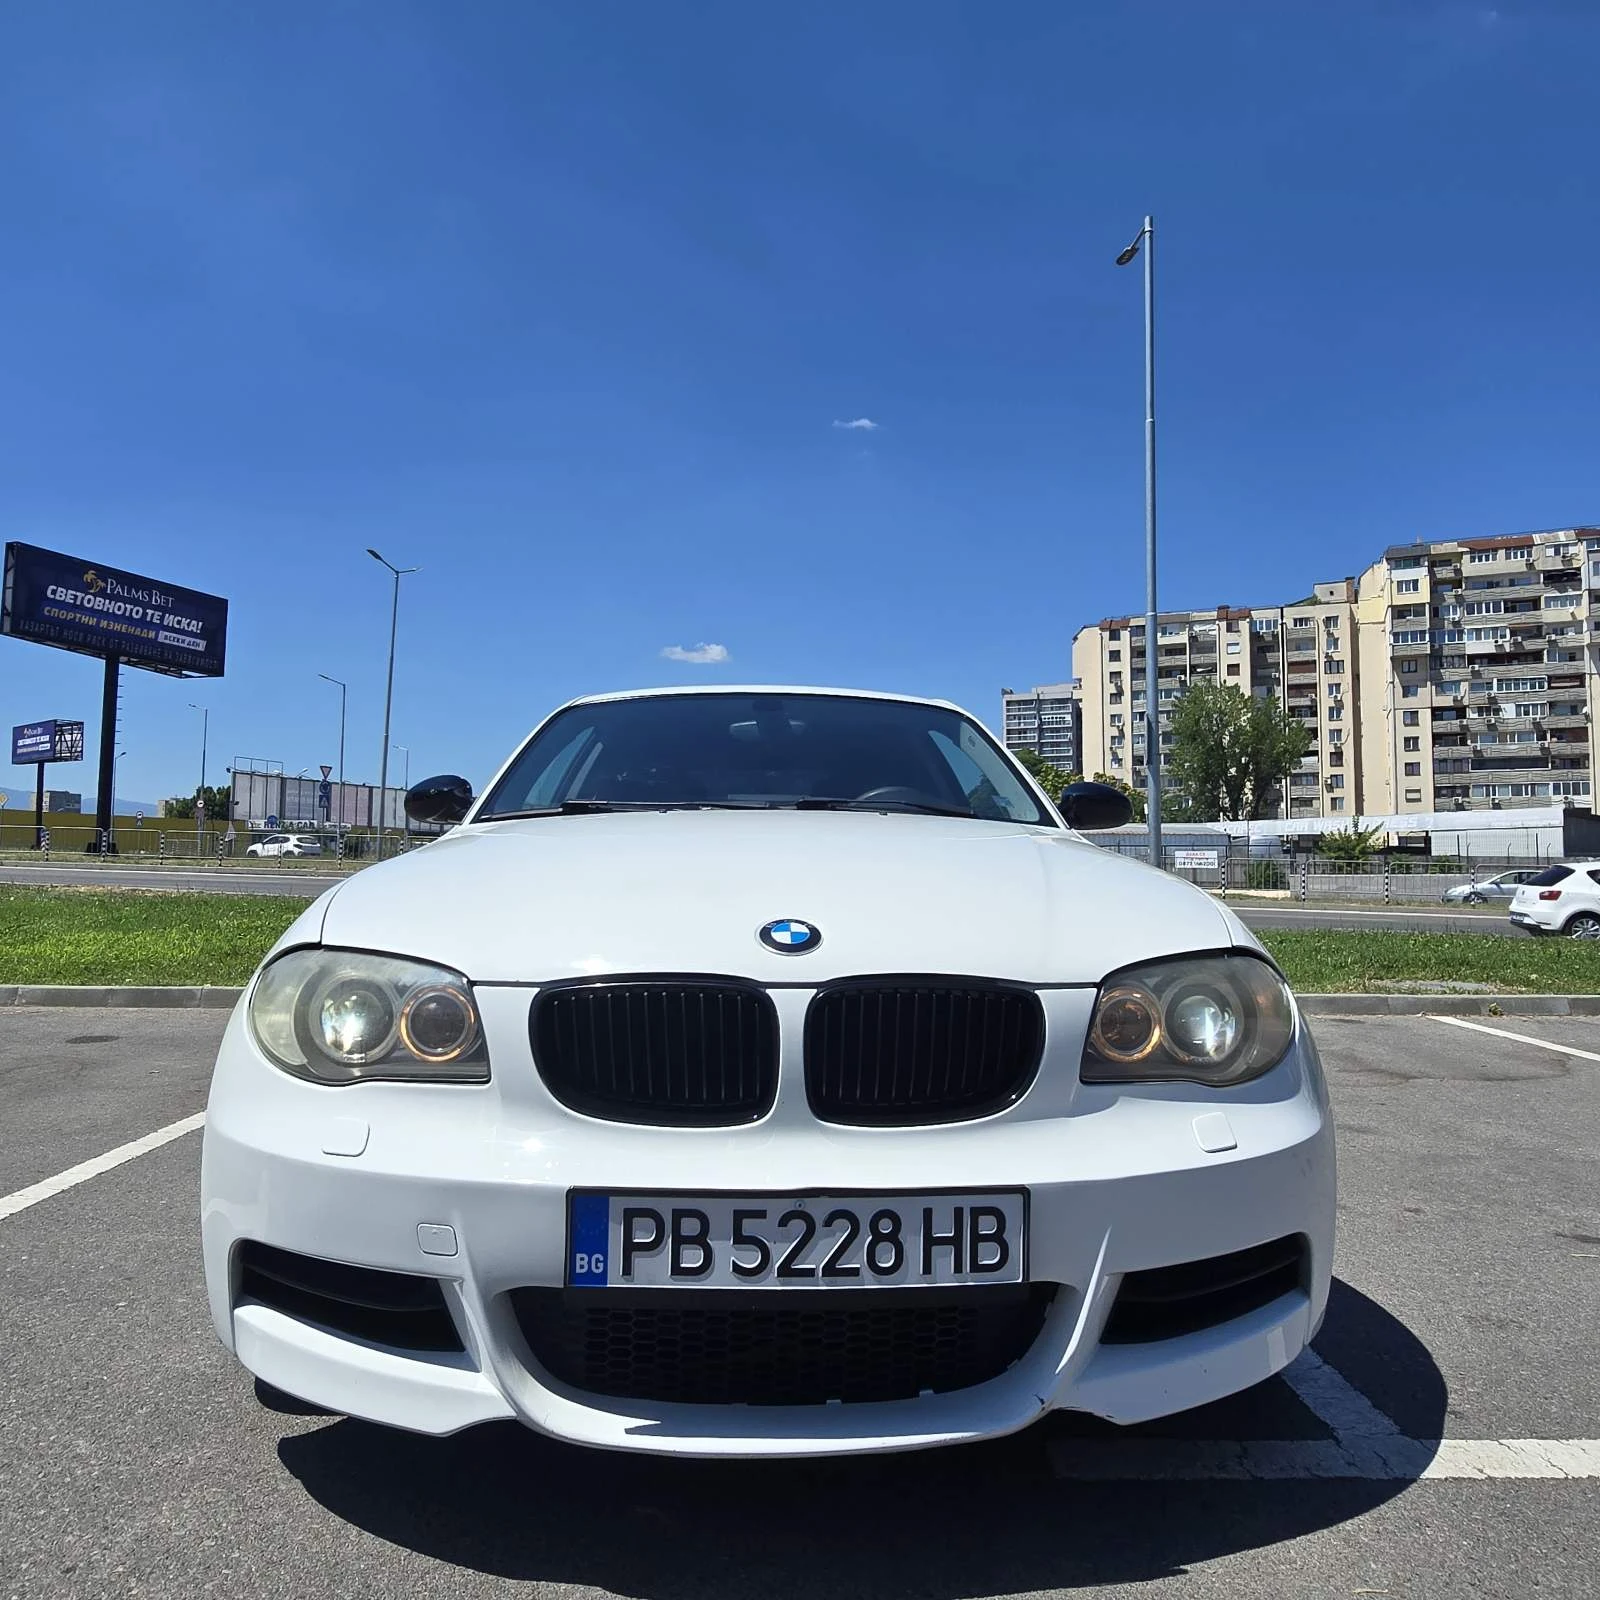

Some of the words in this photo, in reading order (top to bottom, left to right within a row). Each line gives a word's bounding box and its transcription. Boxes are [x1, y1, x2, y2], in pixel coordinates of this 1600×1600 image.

[46, 585, 143, 619] СВЕТОВНОТО
[146, 608, 162, 624] ТЕ
[163, 613, 204, 634] ИСКА!
[106, 578, 149, 602] PALMS
[152, 589, 175, 608] BET
[44, 606, 97, 626] СПОРТНИ
[99, 618, 156, 640] ИЗНЕНАДИ
[621, 1207, 712, 1278] PB
[730, 1208, 903, 1279] 5228
[921, 1205, 1010, 1275] HB
[575, 1253, 605, 1274] BG
